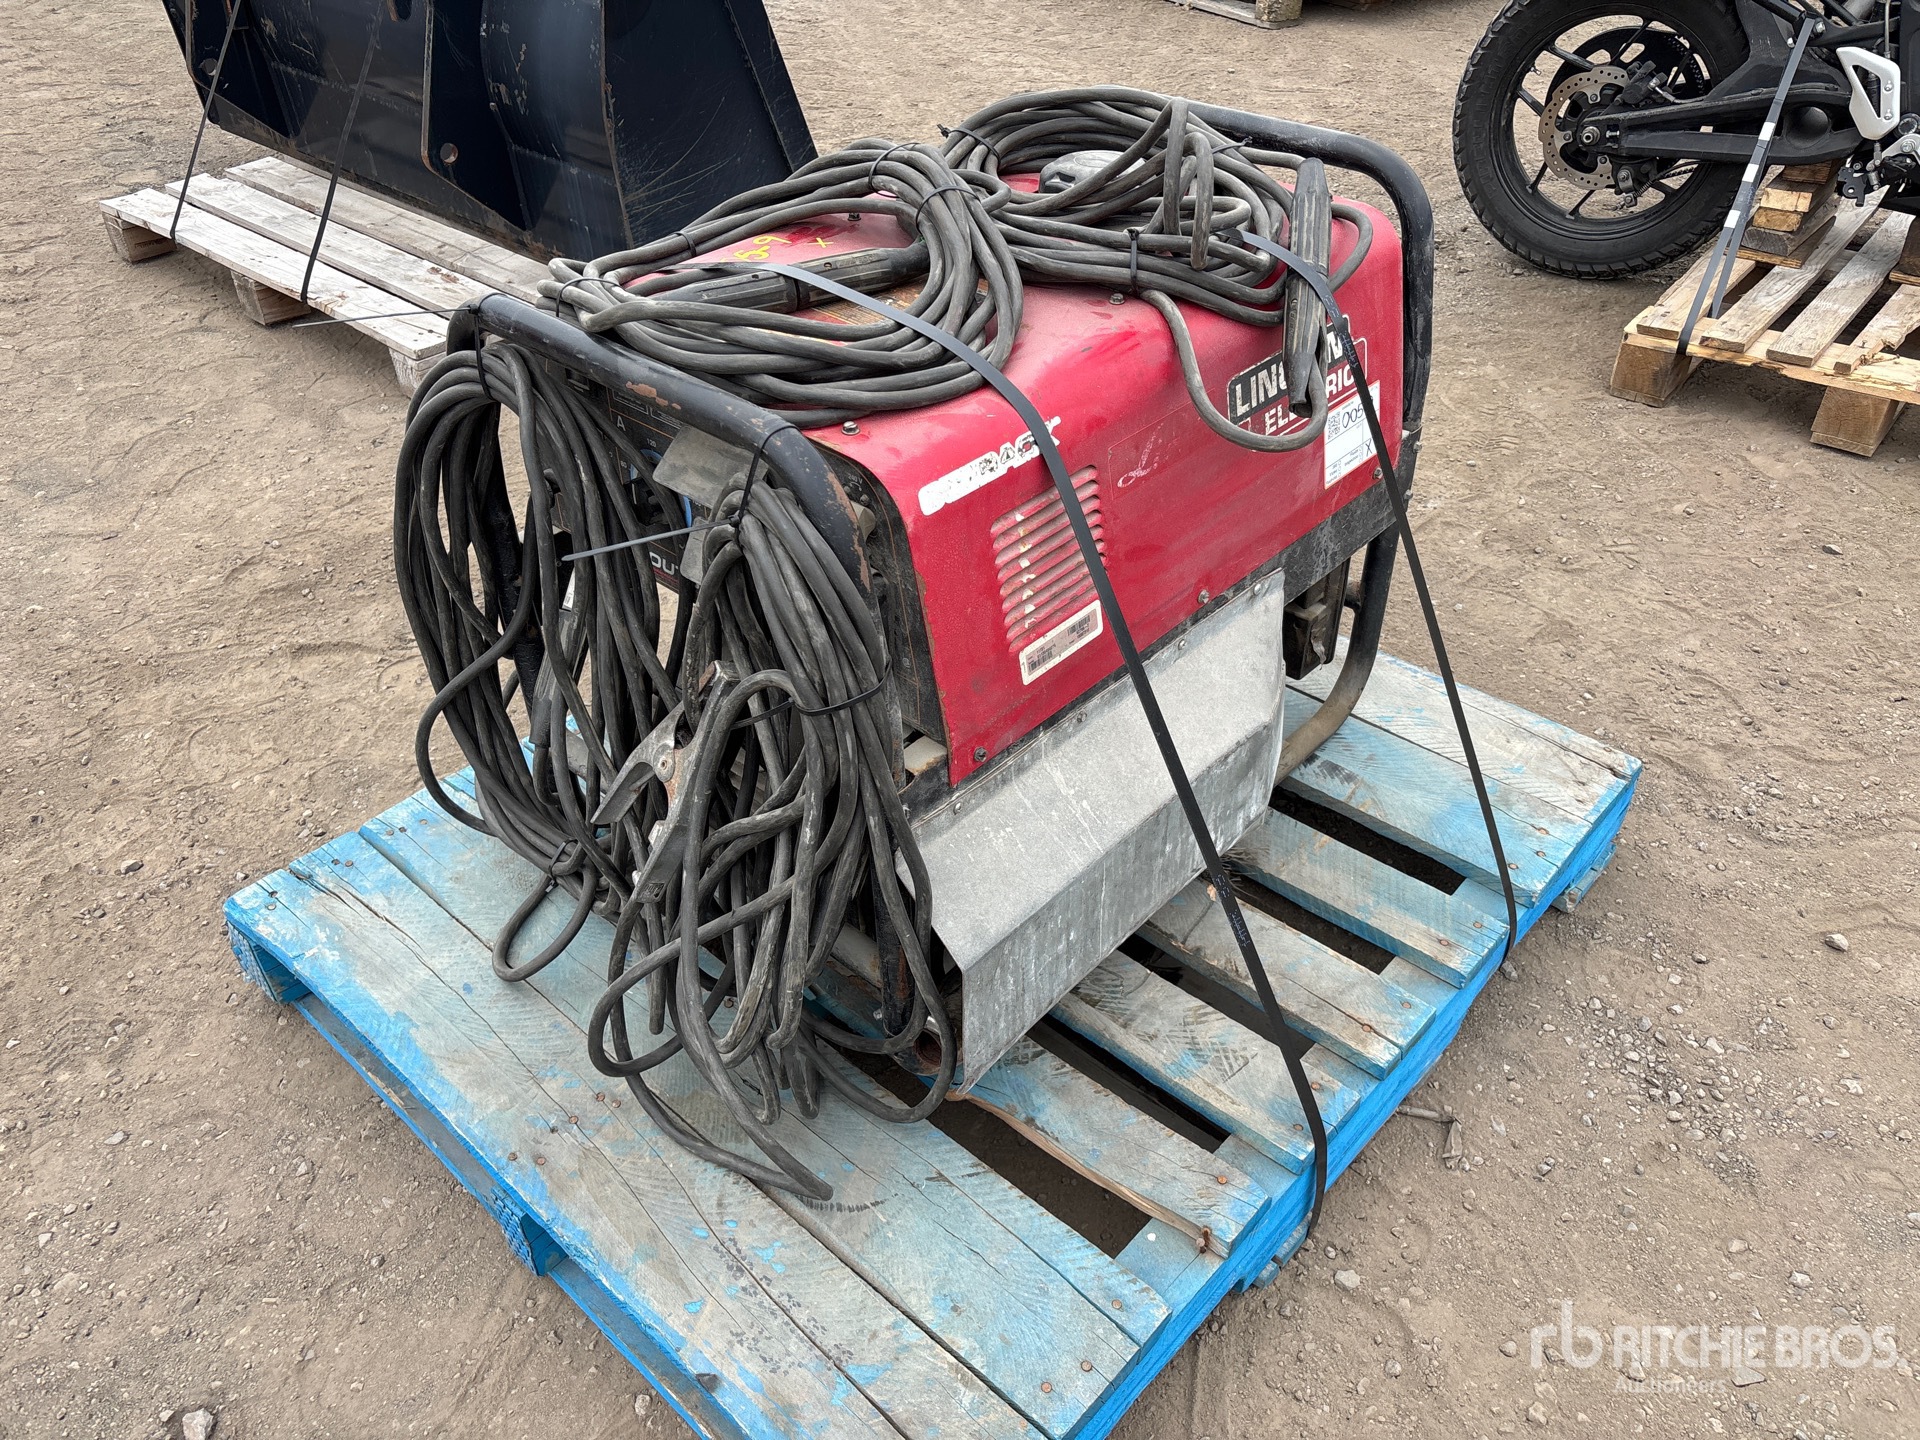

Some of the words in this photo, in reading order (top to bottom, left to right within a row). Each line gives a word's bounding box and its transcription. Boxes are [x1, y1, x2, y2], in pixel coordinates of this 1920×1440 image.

[1235, 331, 1343, 417] LINN
[1265, 364, 1355, 436] ELRIC
[649, 551, 679, 575] OU
